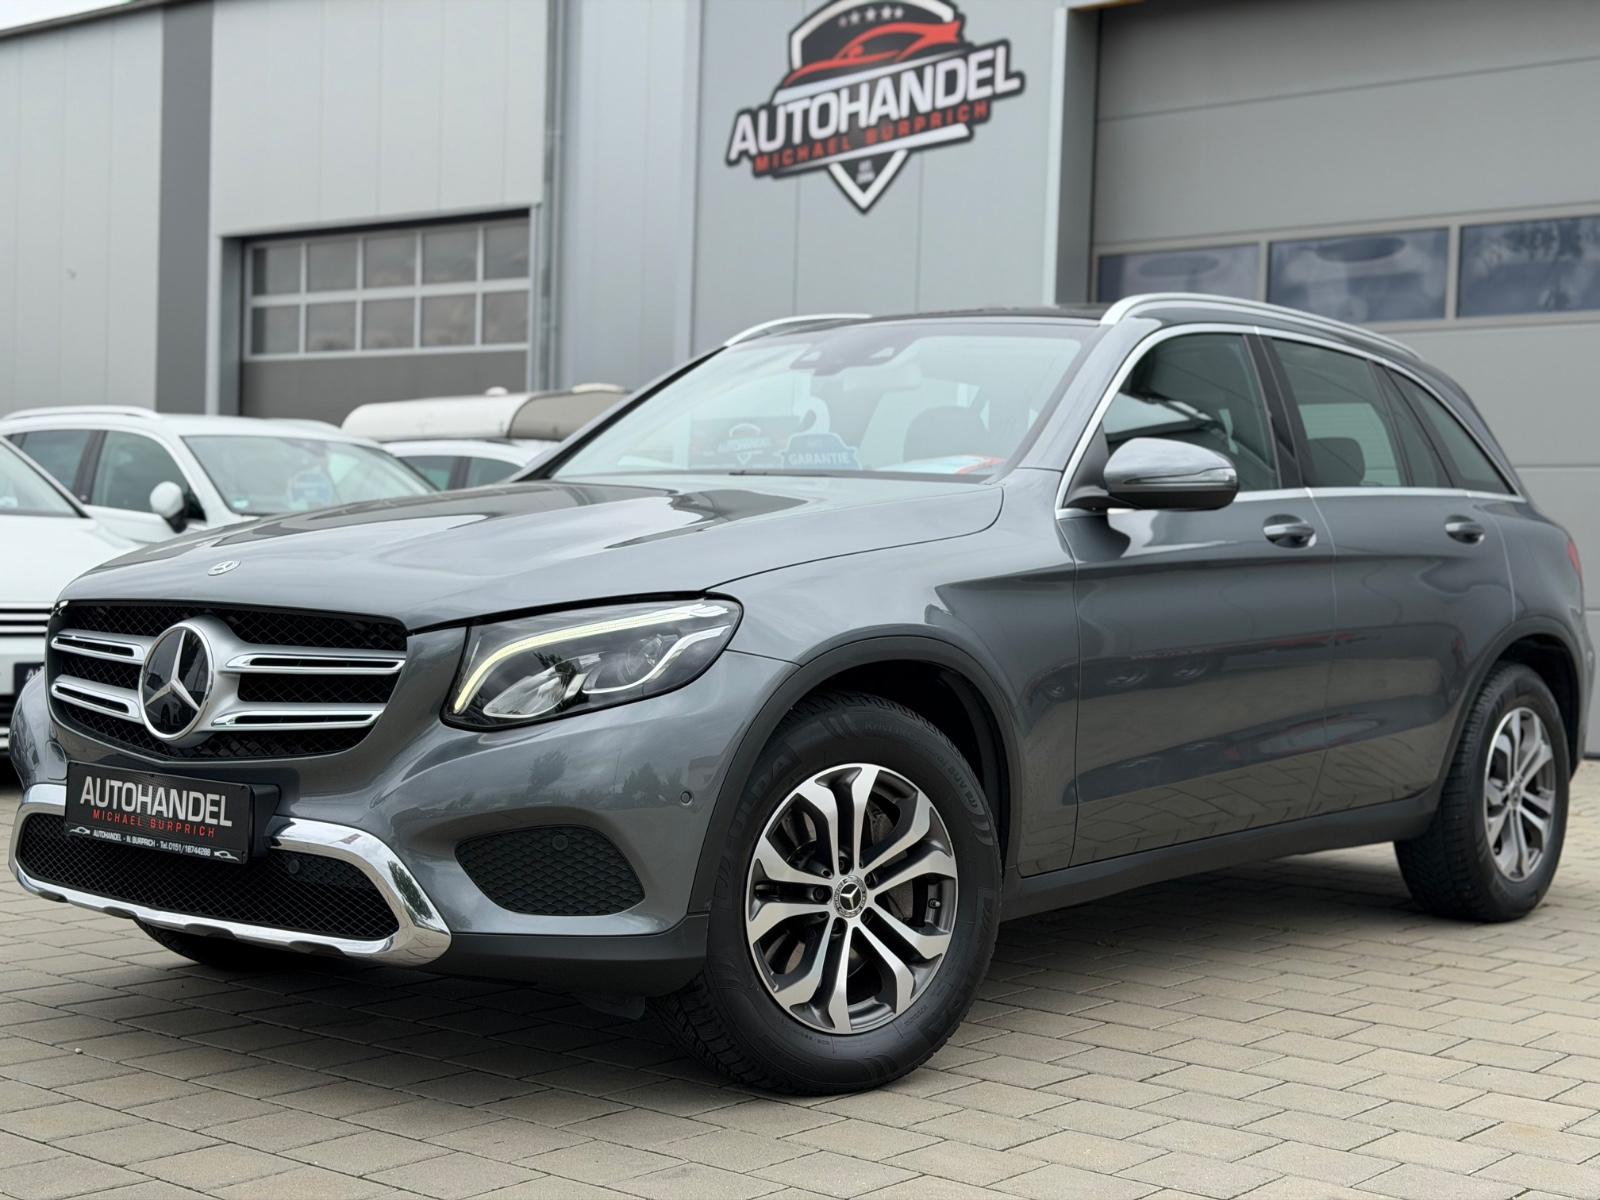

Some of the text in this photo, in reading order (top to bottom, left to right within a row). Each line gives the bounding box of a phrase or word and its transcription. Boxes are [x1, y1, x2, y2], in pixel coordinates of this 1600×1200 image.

[728, 45, 1021, 162] AUTOHANDEL
[754, 135, 852, 172] MICHAEL
[788, 452, 850, 465] GARANTIE
[80, 776, 233, 827] AUTOHANDEL
[92, 809, 143, 827] MICHAEL
[93, 829, 122, 841] AUTOHANDEL
